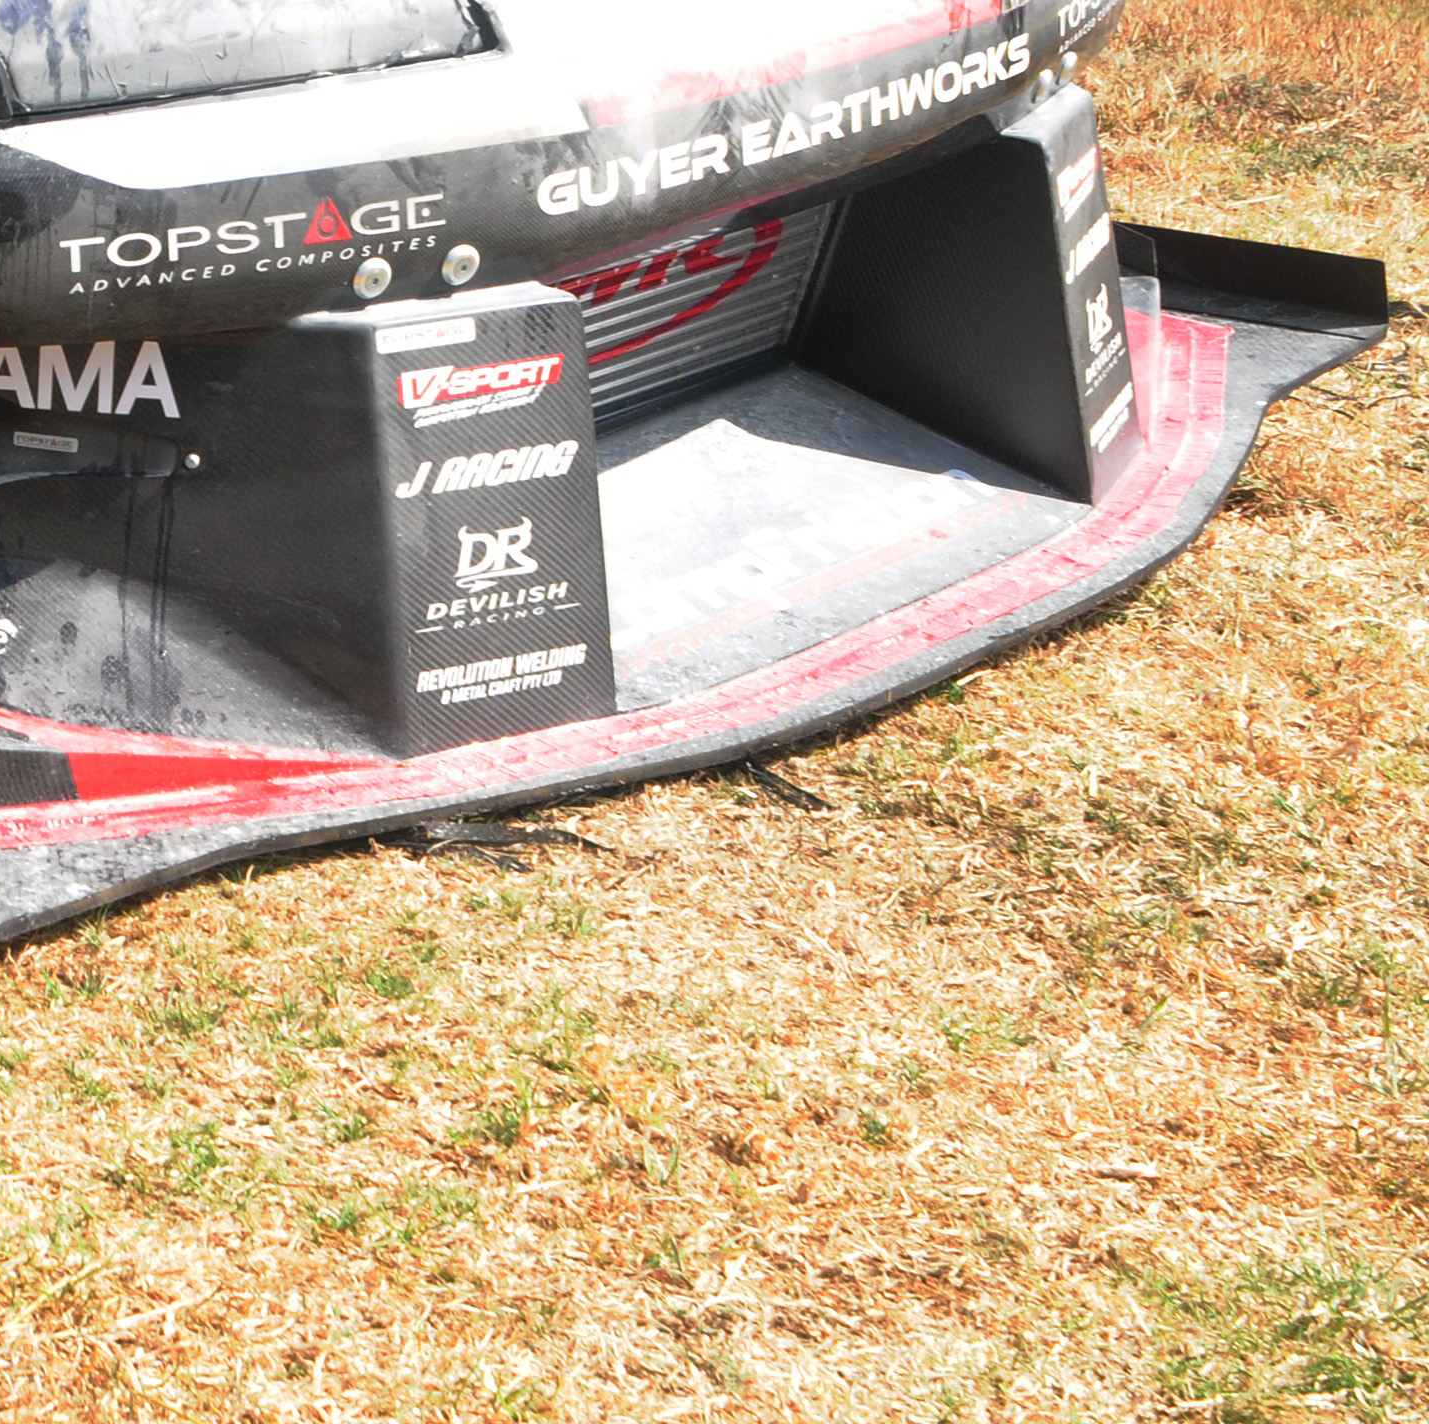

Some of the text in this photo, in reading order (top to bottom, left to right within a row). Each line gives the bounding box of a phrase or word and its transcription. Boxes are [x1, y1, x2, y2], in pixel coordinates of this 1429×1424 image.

[537, 32, 1030, 216] GUYER EARTHWORKS
[59, 193, 447, 273] TOPSTAGE
[69, 235, 438, 295] ADVANCED COMPOSITES
[395, 439, 579, 499] J RACING
[453, 516, 539, 592] DR
[426, 581, 569, 620] DEVILISH
[453, 606, 546, 630] RACING
[416, 643, 588, 693] REVOLUTION WELDING
[452, 683, 488, 703] METAL
[488, 677, 523, 696] CRAFT
[522, 673, 543, 690] PTY
[542, 670, 563, 687] LTD
